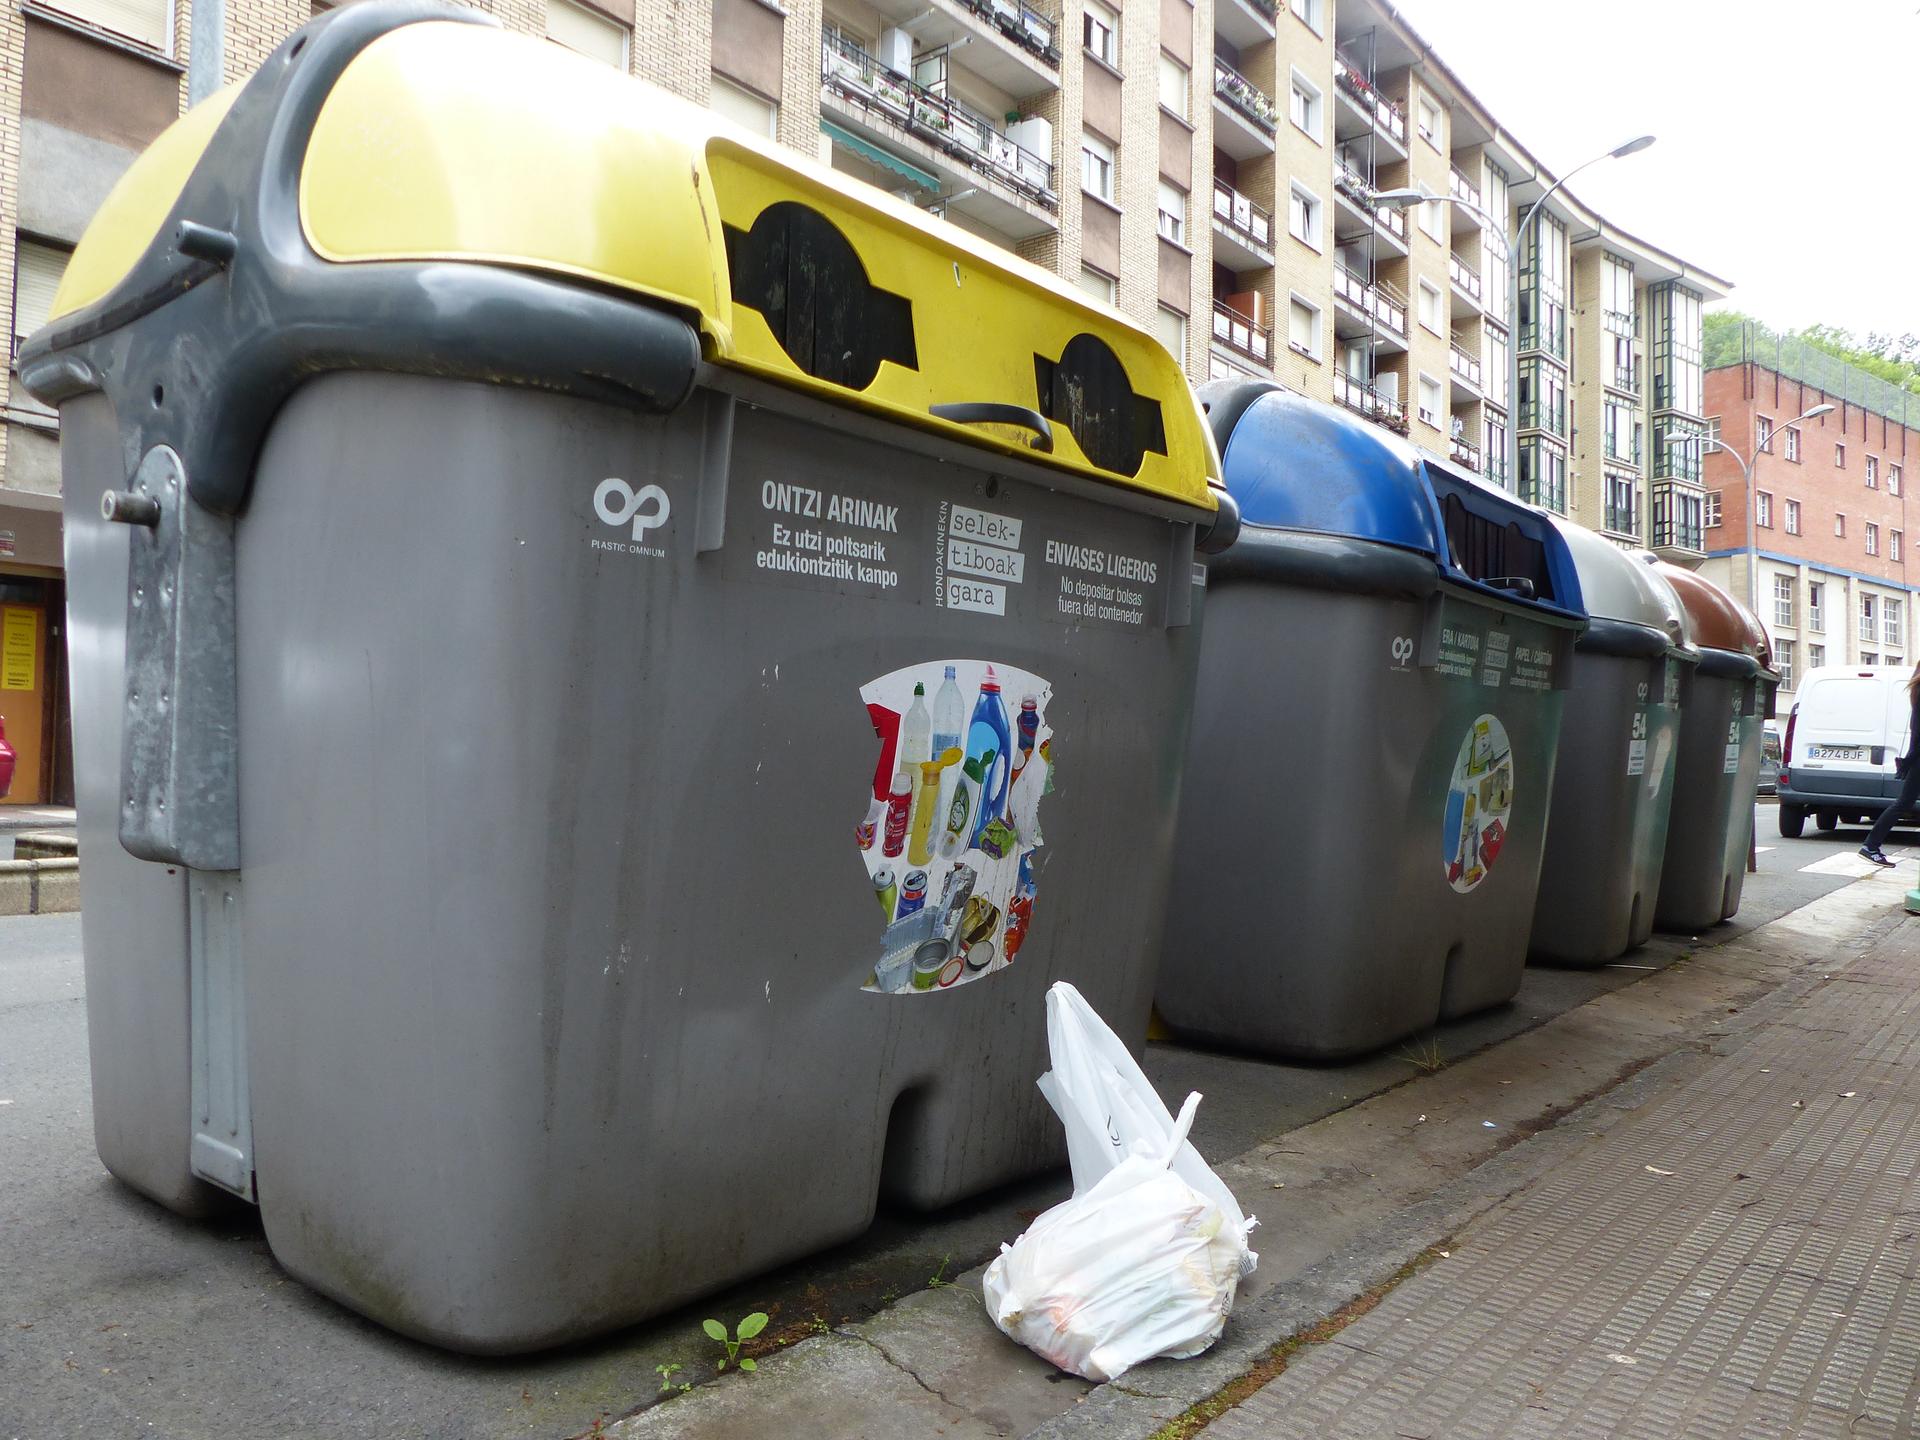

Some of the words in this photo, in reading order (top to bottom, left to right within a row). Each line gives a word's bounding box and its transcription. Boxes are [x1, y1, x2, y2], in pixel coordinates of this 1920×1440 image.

[761, 480, 821, 519] ONTZI
[827, 496, 899, 533] ARINAK
[773, 523, 791, 546] Ez
[795, 528, 822, 552] utzi
[826, 533, 886, 562] poltsarik
[953, 514, 1016, 541] selek-
[591, 540, 626, 552] PLASTIC
[629, 545, 665, 558] OMNIUM
[935, 501, 949, 607] HONDAKINEKIN
[951, 546, 1017, 576] tiboak
[1045, 540, 1104, 573] ENVASES
[1107, 553, 1157, 584] LIGEROS
[756, 548, 854, 580] edukiontzitik
[857, 560, 898, 588] kanpo
[950, 584, 994, 606] gara
[1061, 576, 1073, 593] No
[1075, 578, 1115, 603] depositar
[1116, 585, 1142, 606] bolsas
[1058, 596, 1081, 615] fuera
[1084, 600, 1096, 617] del
[1098, 605, 1143, 625] contenedor
[1632, 712, 1646, 738] 54
